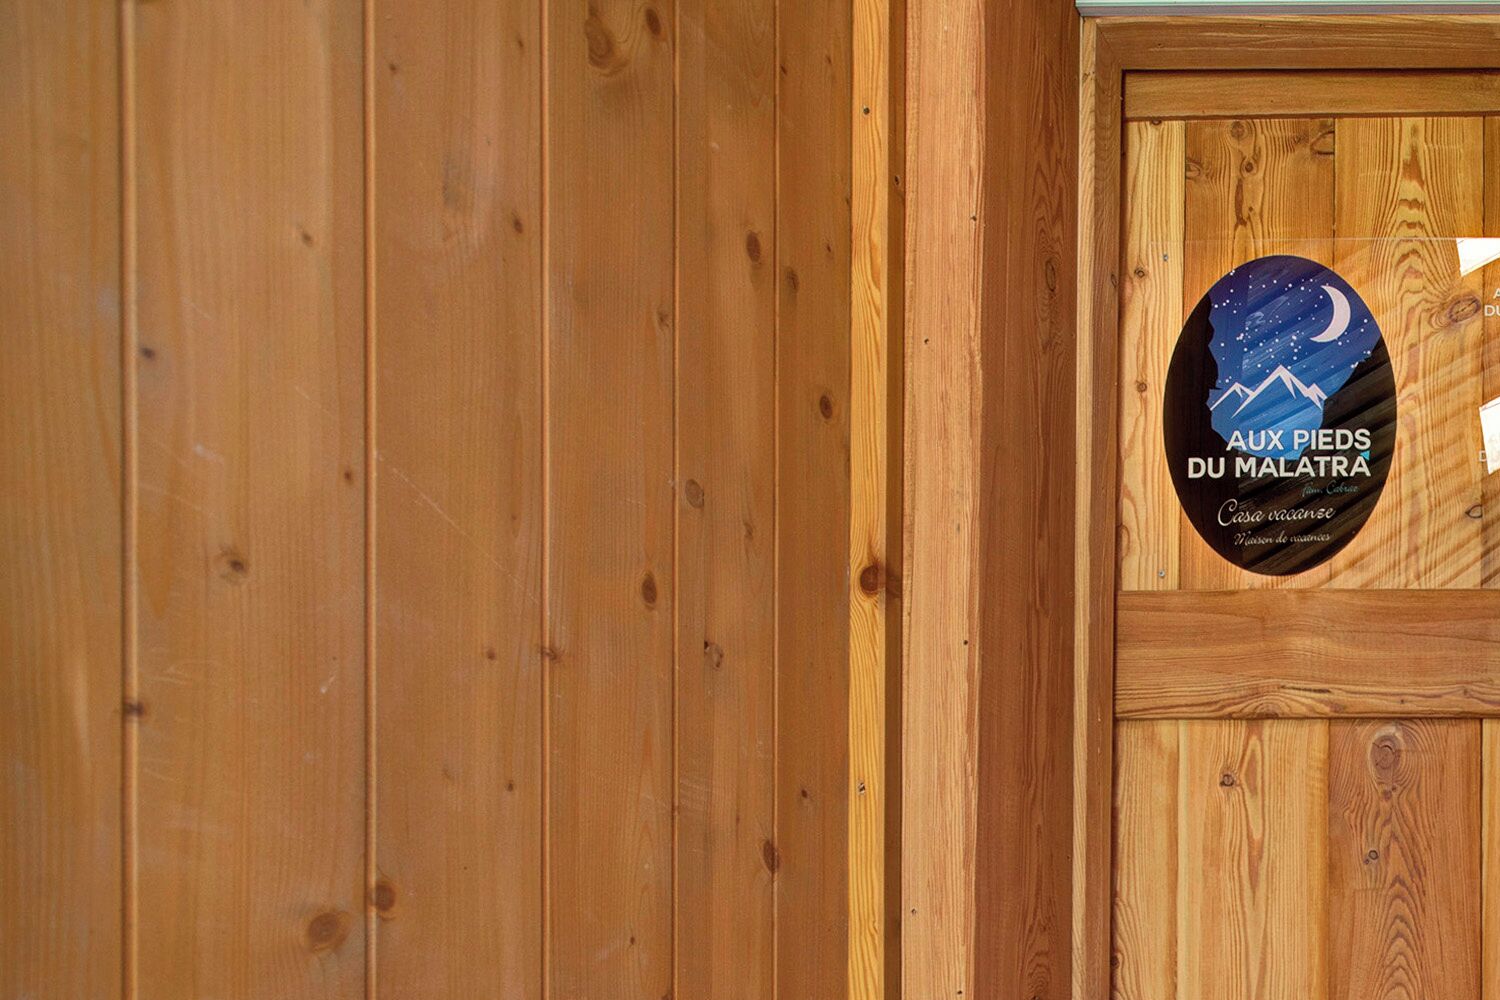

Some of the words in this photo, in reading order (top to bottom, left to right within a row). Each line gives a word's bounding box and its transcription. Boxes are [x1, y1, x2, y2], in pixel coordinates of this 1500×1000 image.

[1226, 430, 1285, 451] AUX
[1293, 428, 1372, 450] PIEDS
[1187, 456, 1226, 479] DU
[1217, 498, 1266, 527] Casa
[1268, 507, 1337, 523] vacanze
